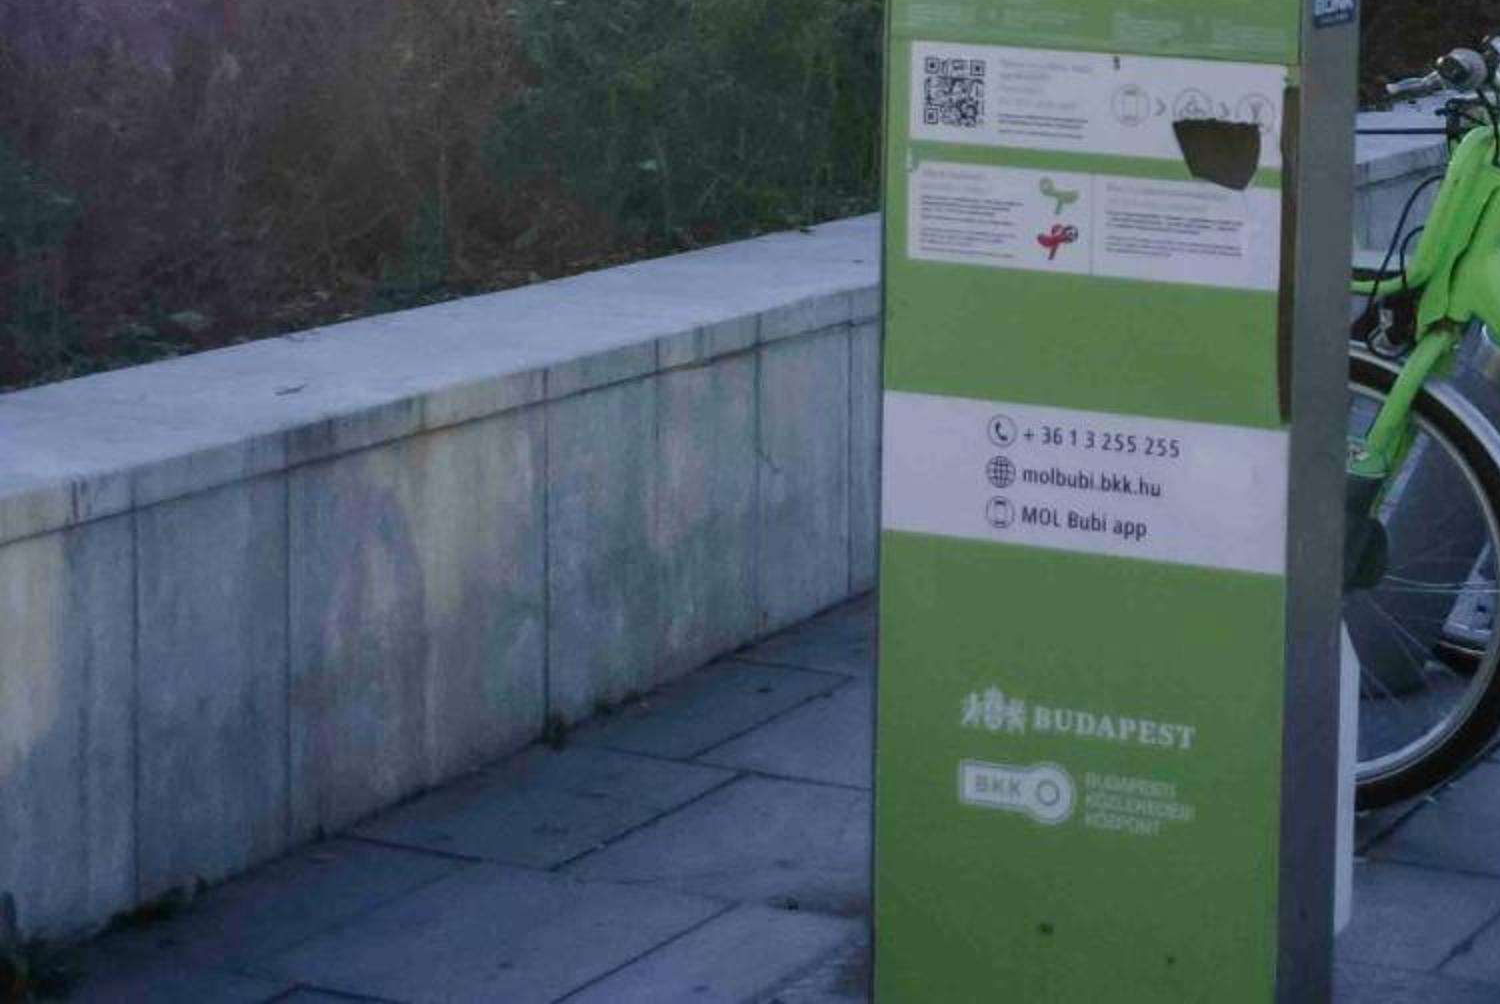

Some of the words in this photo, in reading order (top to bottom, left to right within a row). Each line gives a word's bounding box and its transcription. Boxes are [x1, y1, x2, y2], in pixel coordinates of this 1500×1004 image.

[1101, 432, 1137, 453] 255
[1144, 436, 1181, 458] 255
[1022, 467, 1162, 497] molbubi.bkk.hu
[1021, 505, 1061, 528] MOL
[1067, 510, 1107, 533] Bubi
[1112, 519, 1148, 542] app
[1032, 705, 1197, 749] BUDAPEST
